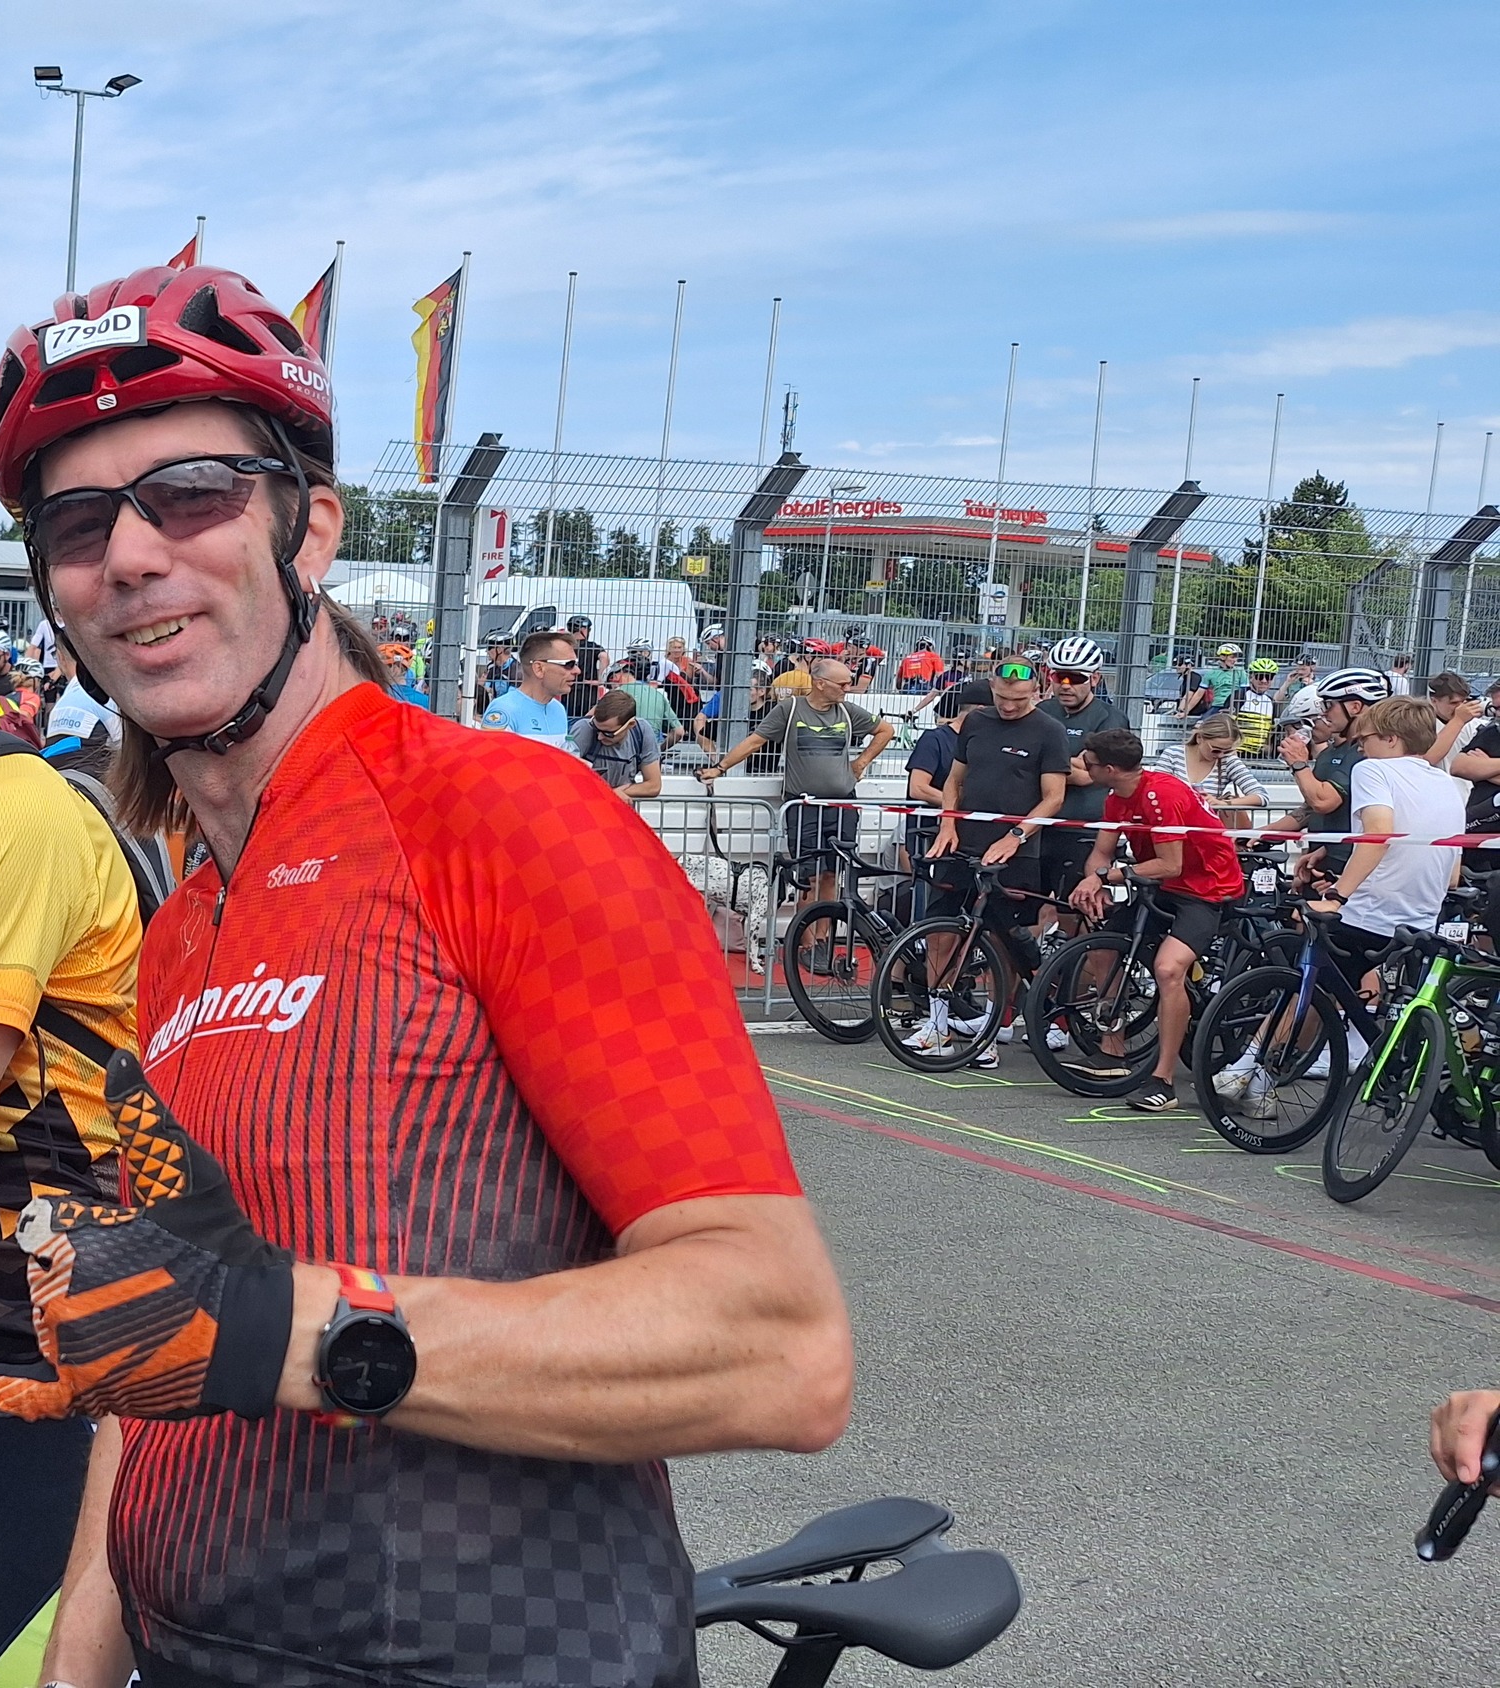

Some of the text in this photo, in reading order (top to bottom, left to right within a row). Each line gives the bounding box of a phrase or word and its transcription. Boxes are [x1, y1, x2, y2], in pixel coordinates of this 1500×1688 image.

[53, 314, 131, 349] 7790D
[281, 361, 330, 396] RUDY
[287, 383, 330, 405] PROJECT
[482, 552, 504, 560] FIRE
[267, 858, 326, 889] Scatta
[1220, 1115, 1263, 1147] DT SWISS
